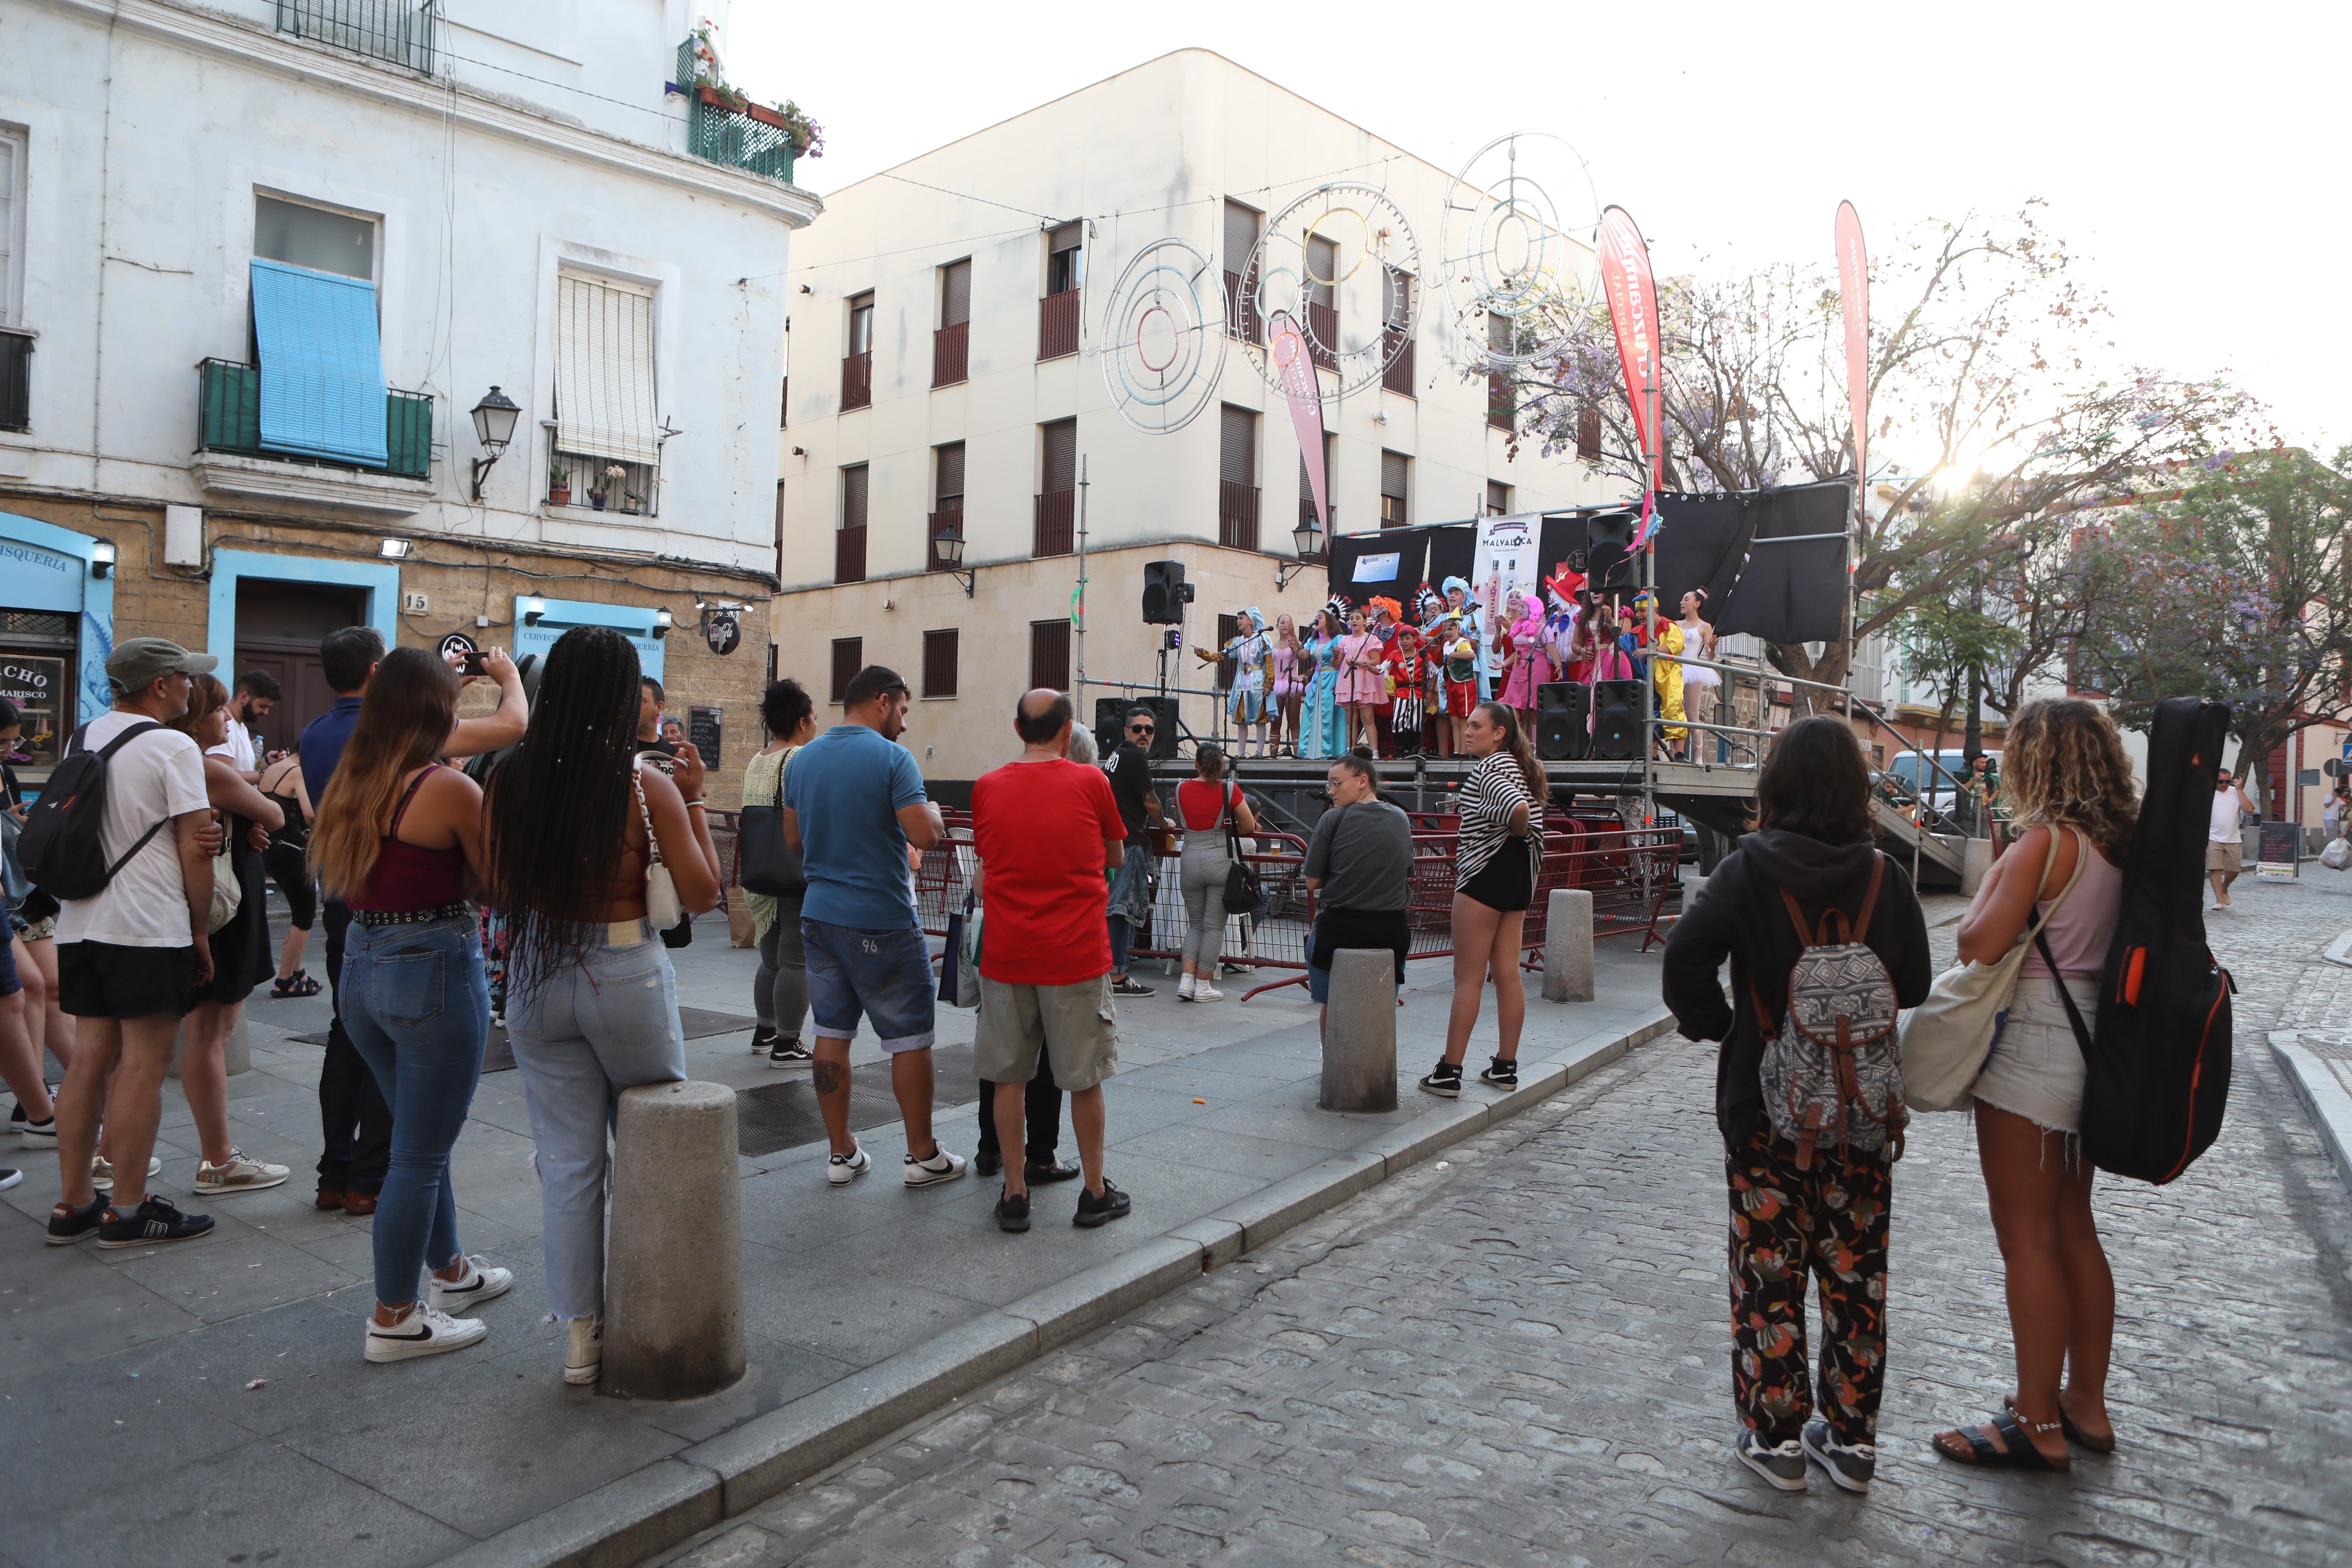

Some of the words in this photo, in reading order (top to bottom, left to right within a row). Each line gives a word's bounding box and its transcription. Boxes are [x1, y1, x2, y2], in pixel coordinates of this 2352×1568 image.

[1483, 536, 1532, 546] MALVALOCA
[406, 594, 425, 609] 15
[634, 642, 659, 651] QUERÍA
[863, 939, 878, 953] 96
